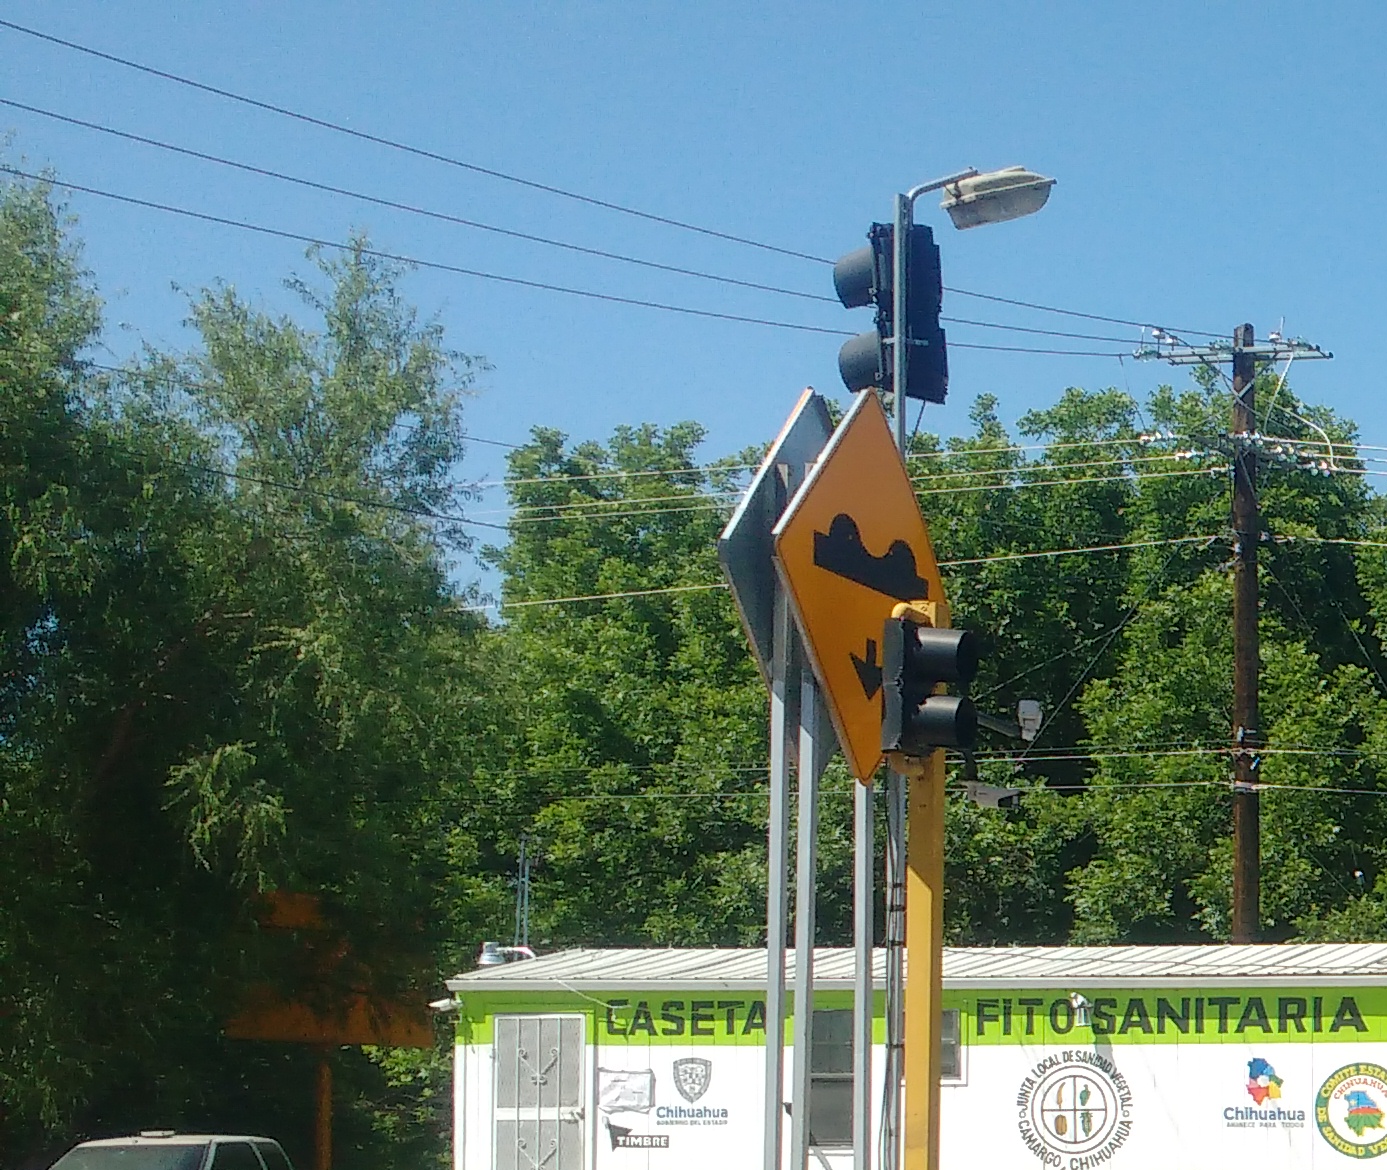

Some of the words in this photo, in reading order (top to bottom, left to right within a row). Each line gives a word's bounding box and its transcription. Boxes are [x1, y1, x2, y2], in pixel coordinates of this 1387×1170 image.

[606, 999, 768, 1036] CASETA
[1017, 1077, 1037, 1110] JUNTA
[1031, 1054, 1062, 1078] LOCAL
[1062, 1050, 1074, 1063] DE
[1075, 1050, 1113, 1074] SANIDAD
[1110, 1068, 1133, 1110] VEGETAL
[1321, 1065, 1357, 1097] COMITE
[656, 1106, 728, 1118] Chihuahua
[1223, 1107, 1305, 1121] Chihuahua
[617, 1136, 669, 1147] TIMBRE
[1070, 1120, 1133, 1170] CHIHUAHUA
